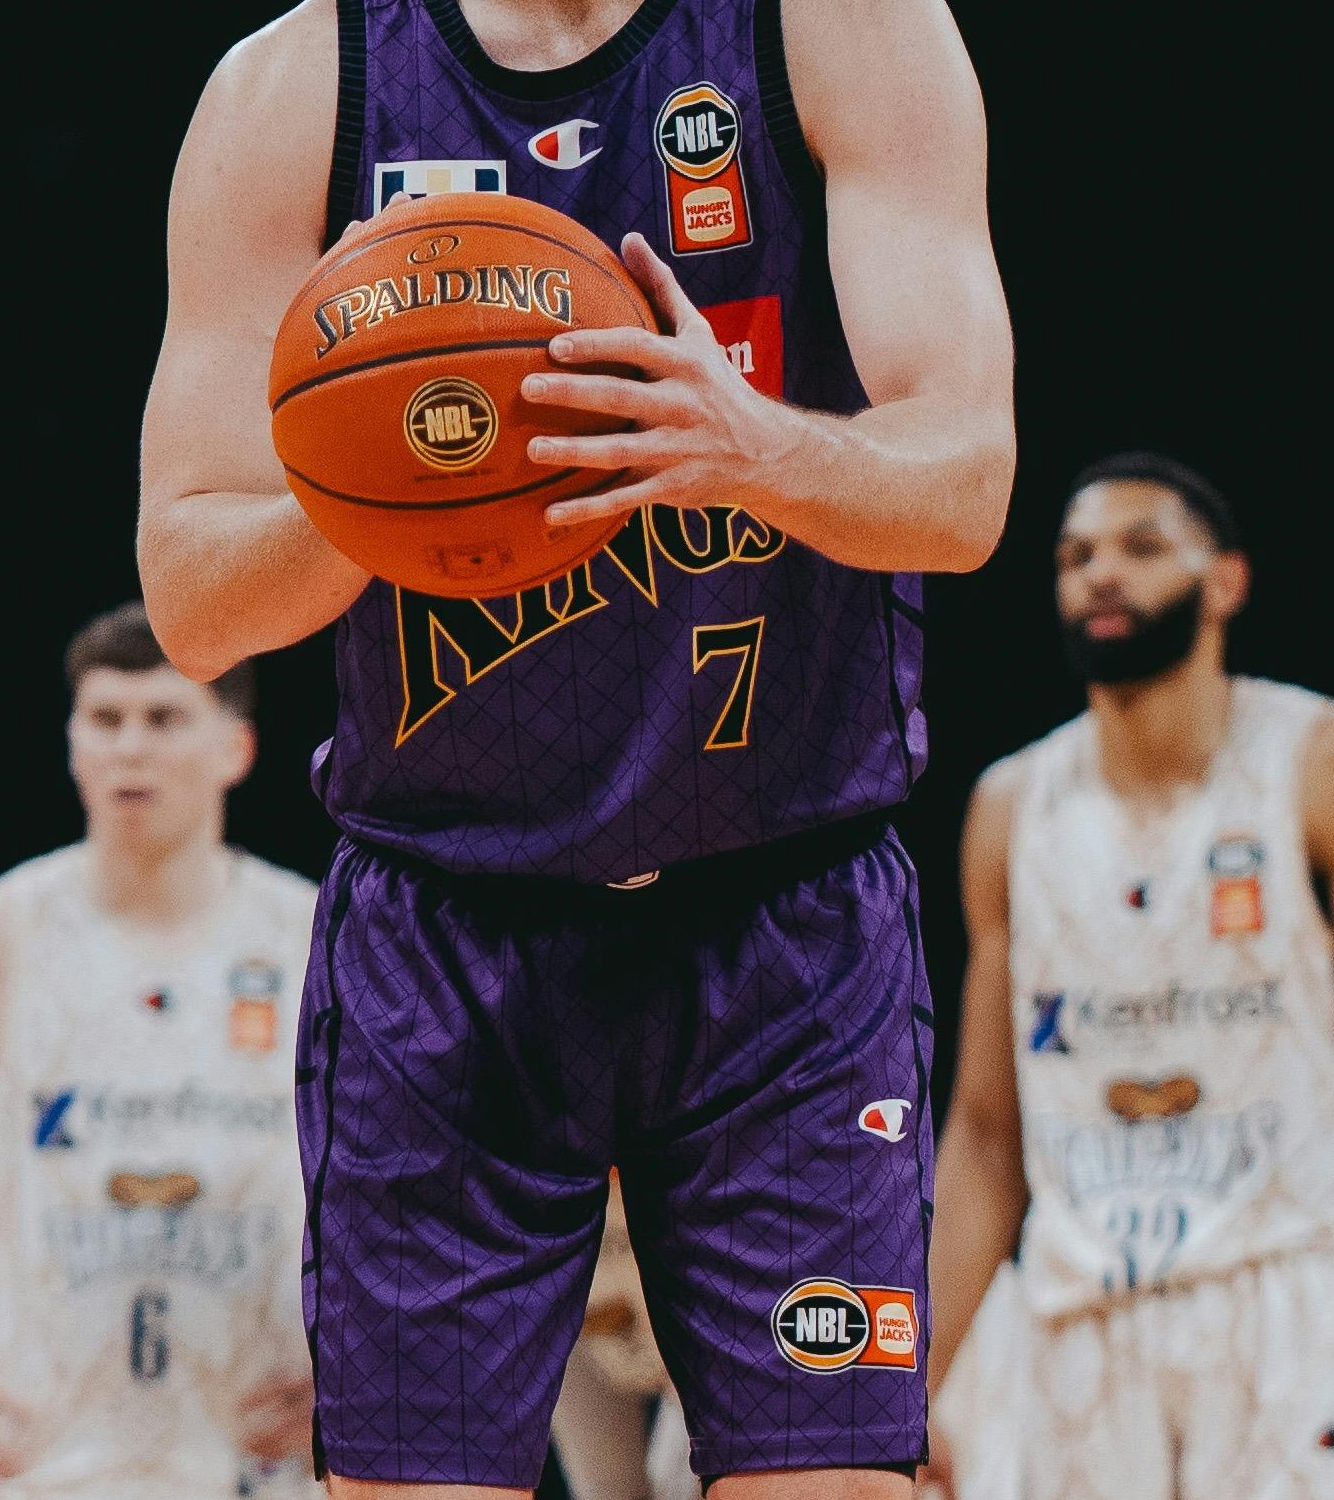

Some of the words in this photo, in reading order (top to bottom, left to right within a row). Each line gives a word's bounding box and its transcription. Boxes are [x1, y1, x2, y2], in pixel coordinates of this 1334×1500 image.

[675, 111, 724, 153] NBL
[685, 200, 730, 216] HUNGRY
[314, 265, 572, 360] SPALDING
[425, 404, 477, 443] NBL
[692, 615, 766, 752] 7
[128, 1289, 171, 1384] 6
[795, 1307, 851, 1344] NBL
[879, 1316, 910, 1328] HUNGRY
